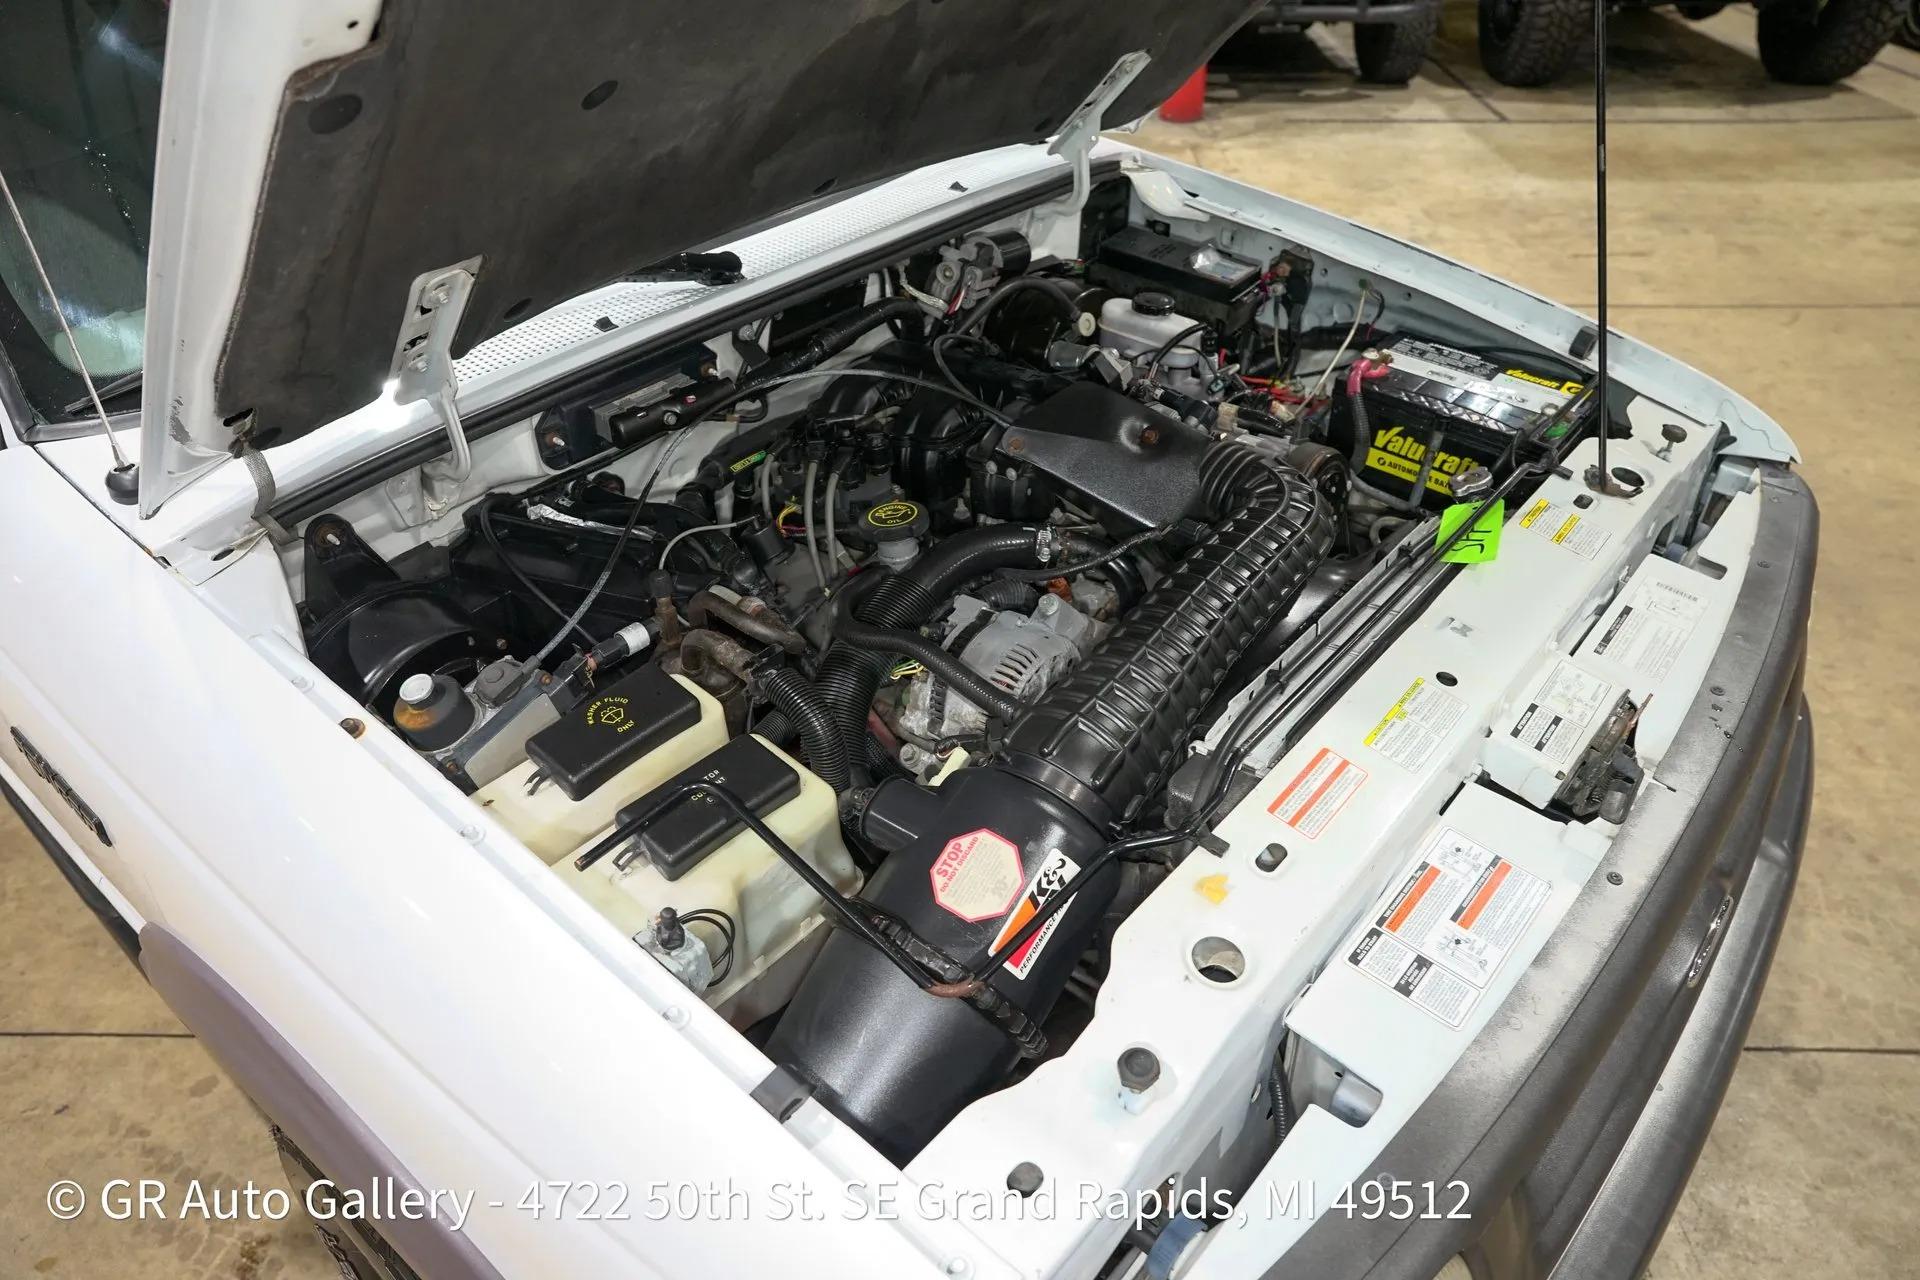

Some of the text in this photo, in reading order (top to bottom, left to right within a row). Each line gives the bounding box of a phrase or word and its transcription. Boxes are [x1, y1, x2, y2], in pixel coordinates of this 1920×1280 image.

[1374, 426, 1480, 476] Valuraf
[617, 720, 635, 732] ONLY
[936, 842, 963, 877] STOP
[940, 836, 979, 893] DO NOT DISCARD
[1018, 915, 1057, 973] PERFORMANCE
